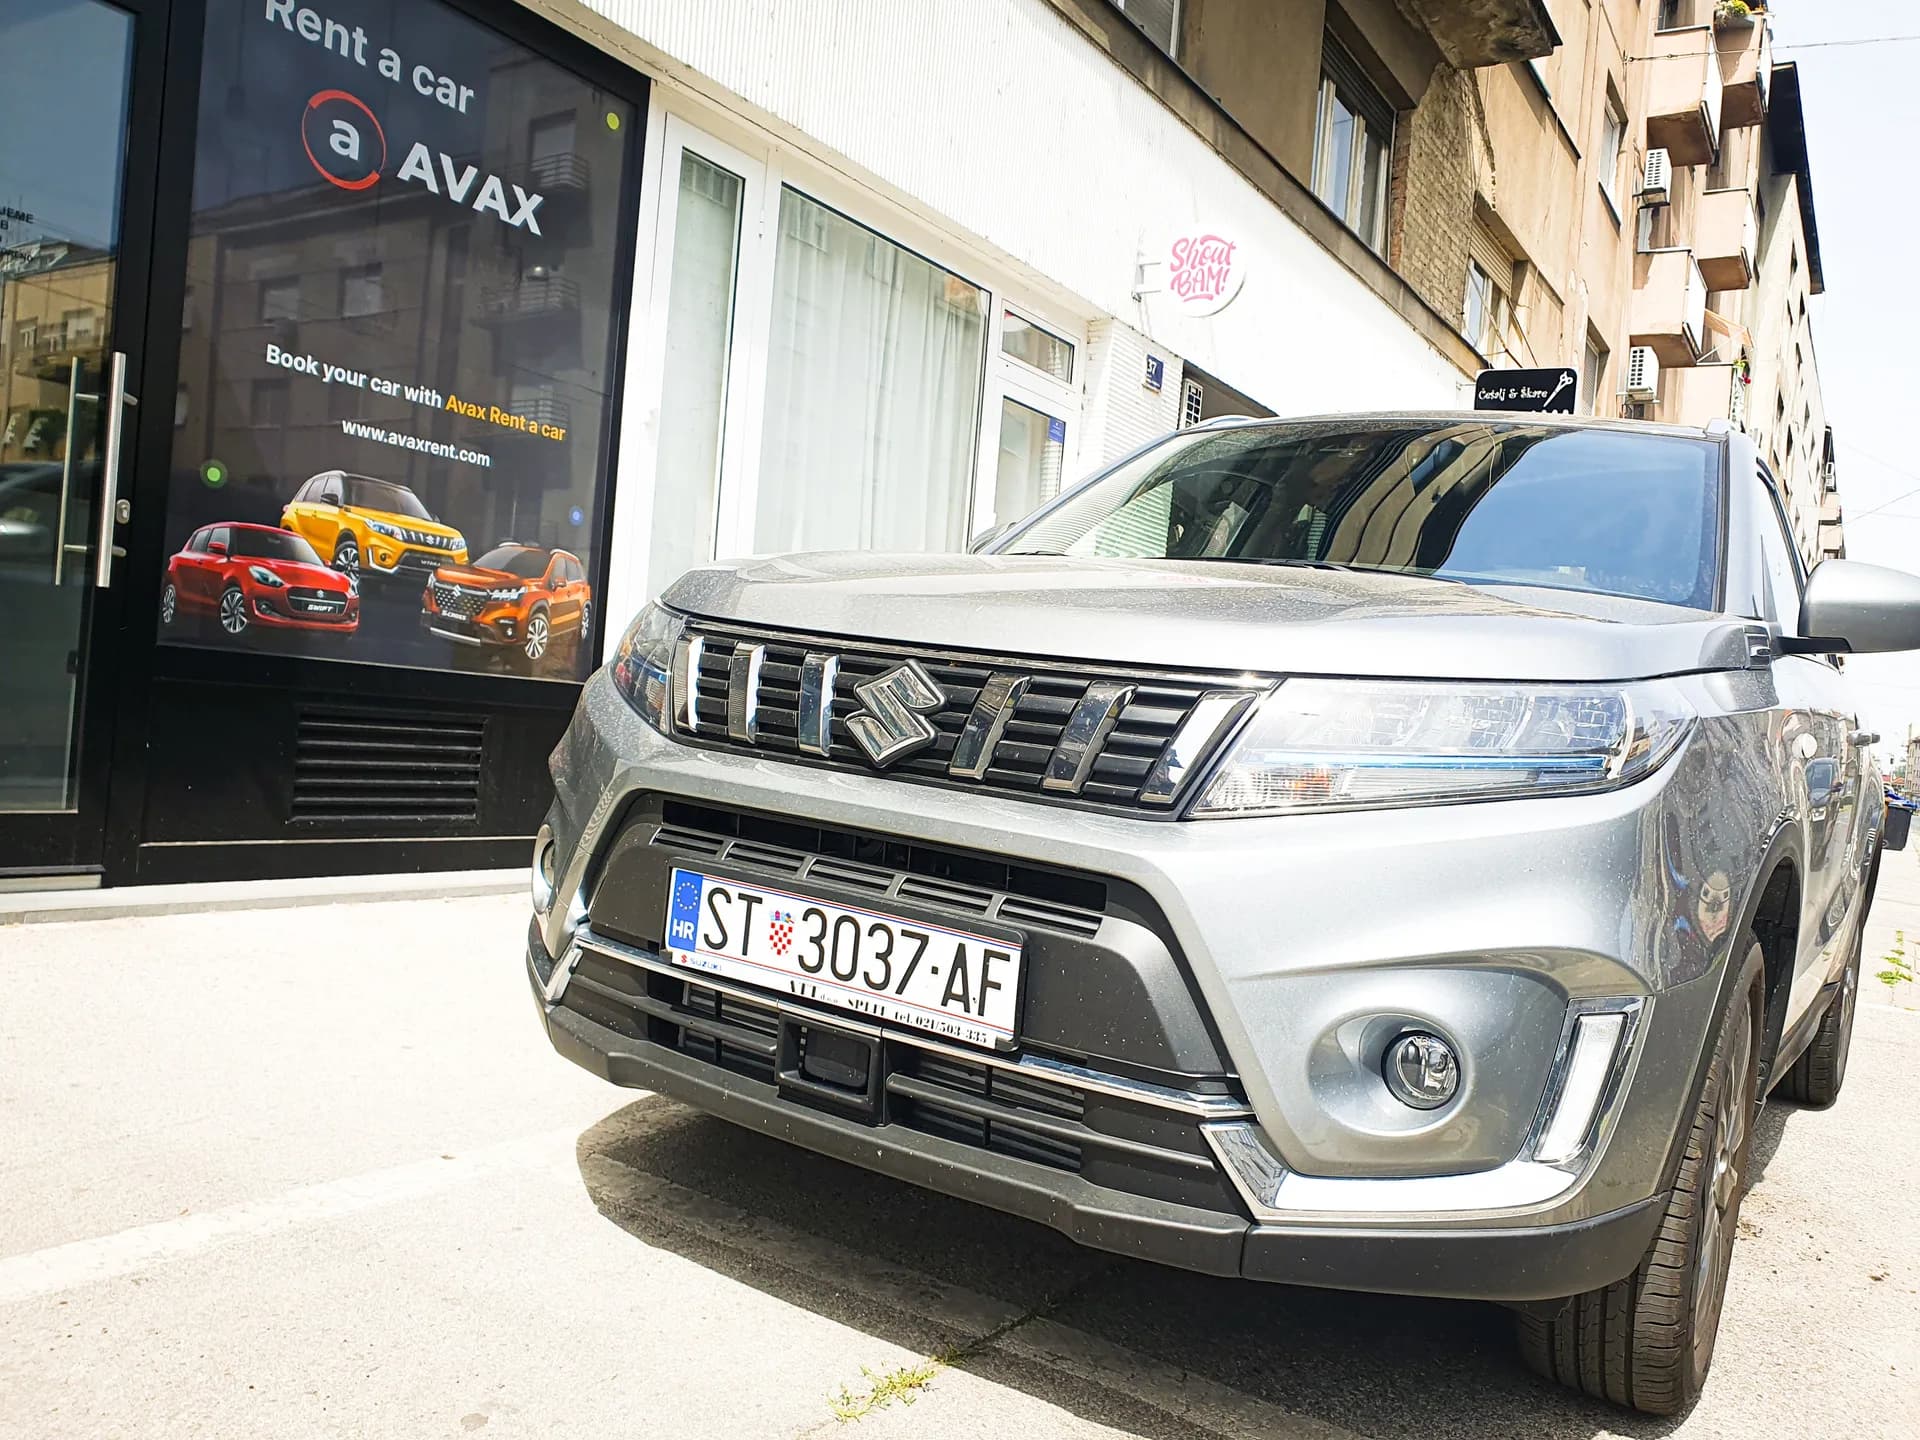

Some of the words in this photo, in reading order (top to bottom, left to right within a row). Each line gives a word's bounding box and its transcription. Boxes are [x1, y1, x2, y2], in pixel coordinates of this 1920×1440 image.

[265, 0, 368, 66] Rent
[378, 48, 401, 82] a
[412, 65, 475, 114] car
[397, 142, 544, 236] AVAX
[1170, 265, 1230, 297] BAM!
[266, 343, 320, 376] Book
[322, 363, 367, 387] your
[370, 376, 400, 397] car
[404, 385, 442, 409] with
[445, 394, 486, 421] Avax
[489, 405, 526, 431] Rent
[528, 420, 538, 434] a
[541, 424, 567, 441] car
[1508, 388, 1519, 399] &
[342, 420, 491, 467] www.avaxrent.com
[672, 918, 695, 942] HR
[703, 886, 763, 957] ST
